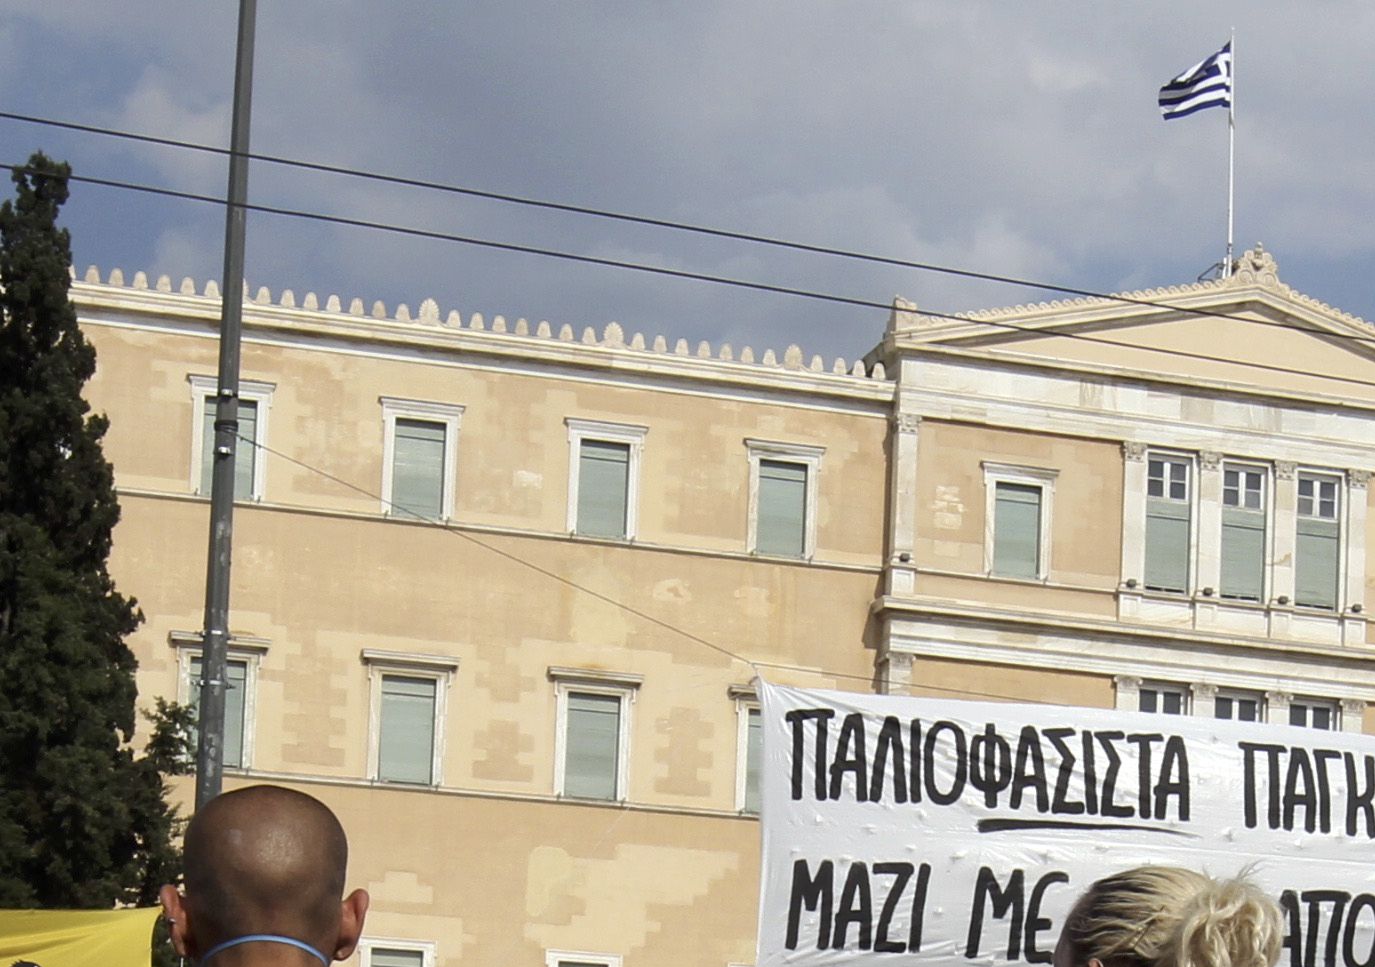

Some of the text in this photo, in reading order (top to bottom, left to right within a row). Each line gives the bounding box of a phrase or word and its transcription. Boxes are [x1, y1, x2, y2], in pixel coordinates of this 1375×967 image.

[785, 708, 1190, 821] ΠΑΛΙΟΦΑΣΙΣΤΑ
[785, 859, 931, 954] ΜΑΖΙ
[964, 866, 1069, 964] ΜΕ
